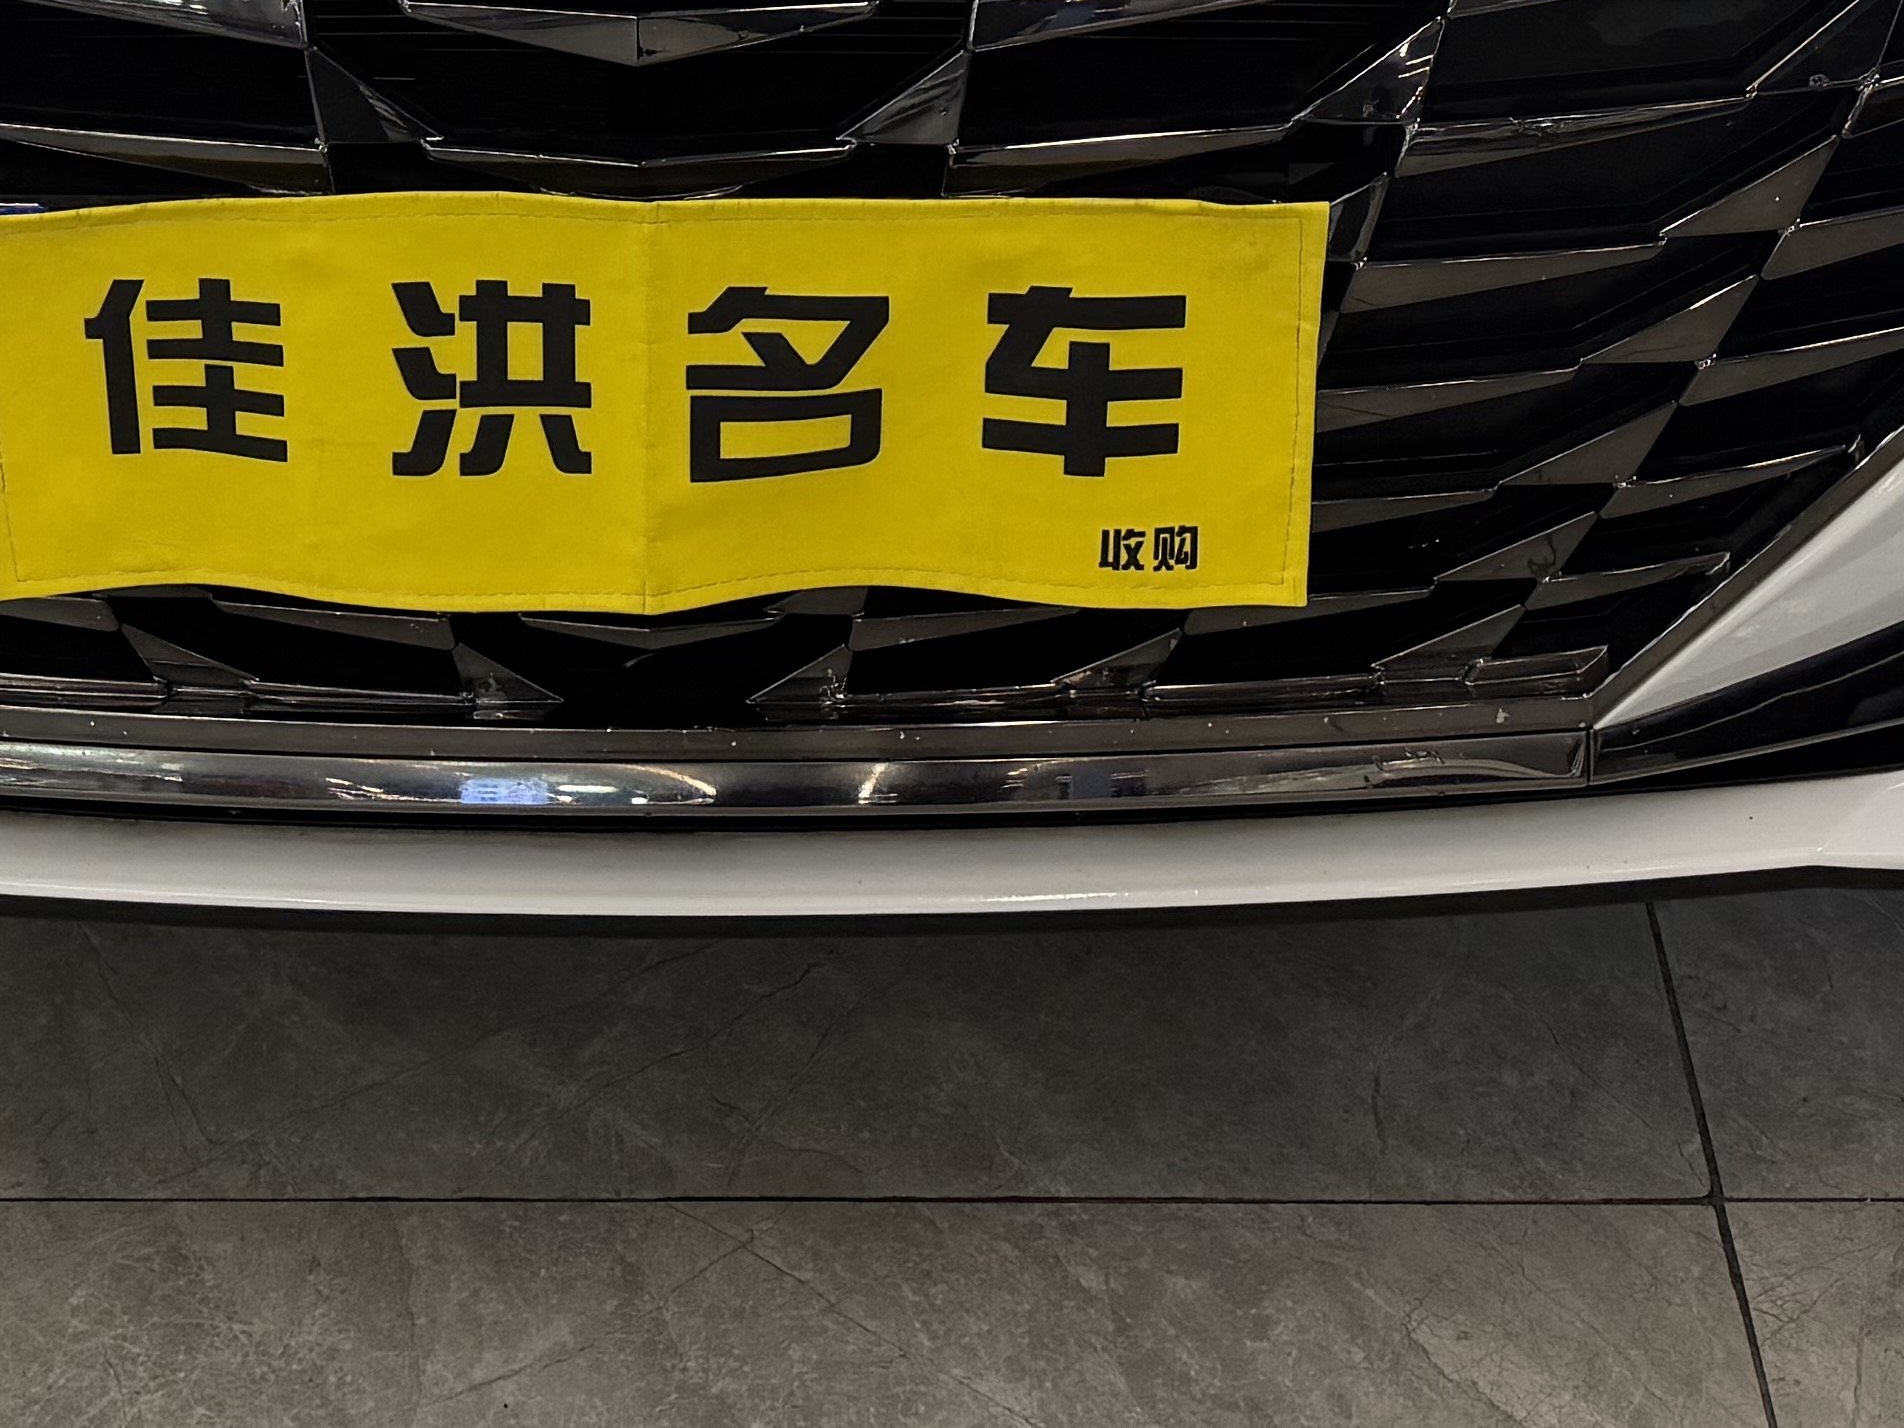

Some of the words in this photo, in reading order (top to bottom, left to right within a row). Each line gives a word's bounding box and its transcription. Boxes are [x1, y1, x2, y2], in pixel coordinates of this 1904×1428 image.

[85, 277, 1187, 483] 佳洪名车
[1099, 525, 1199, 572] 收购
